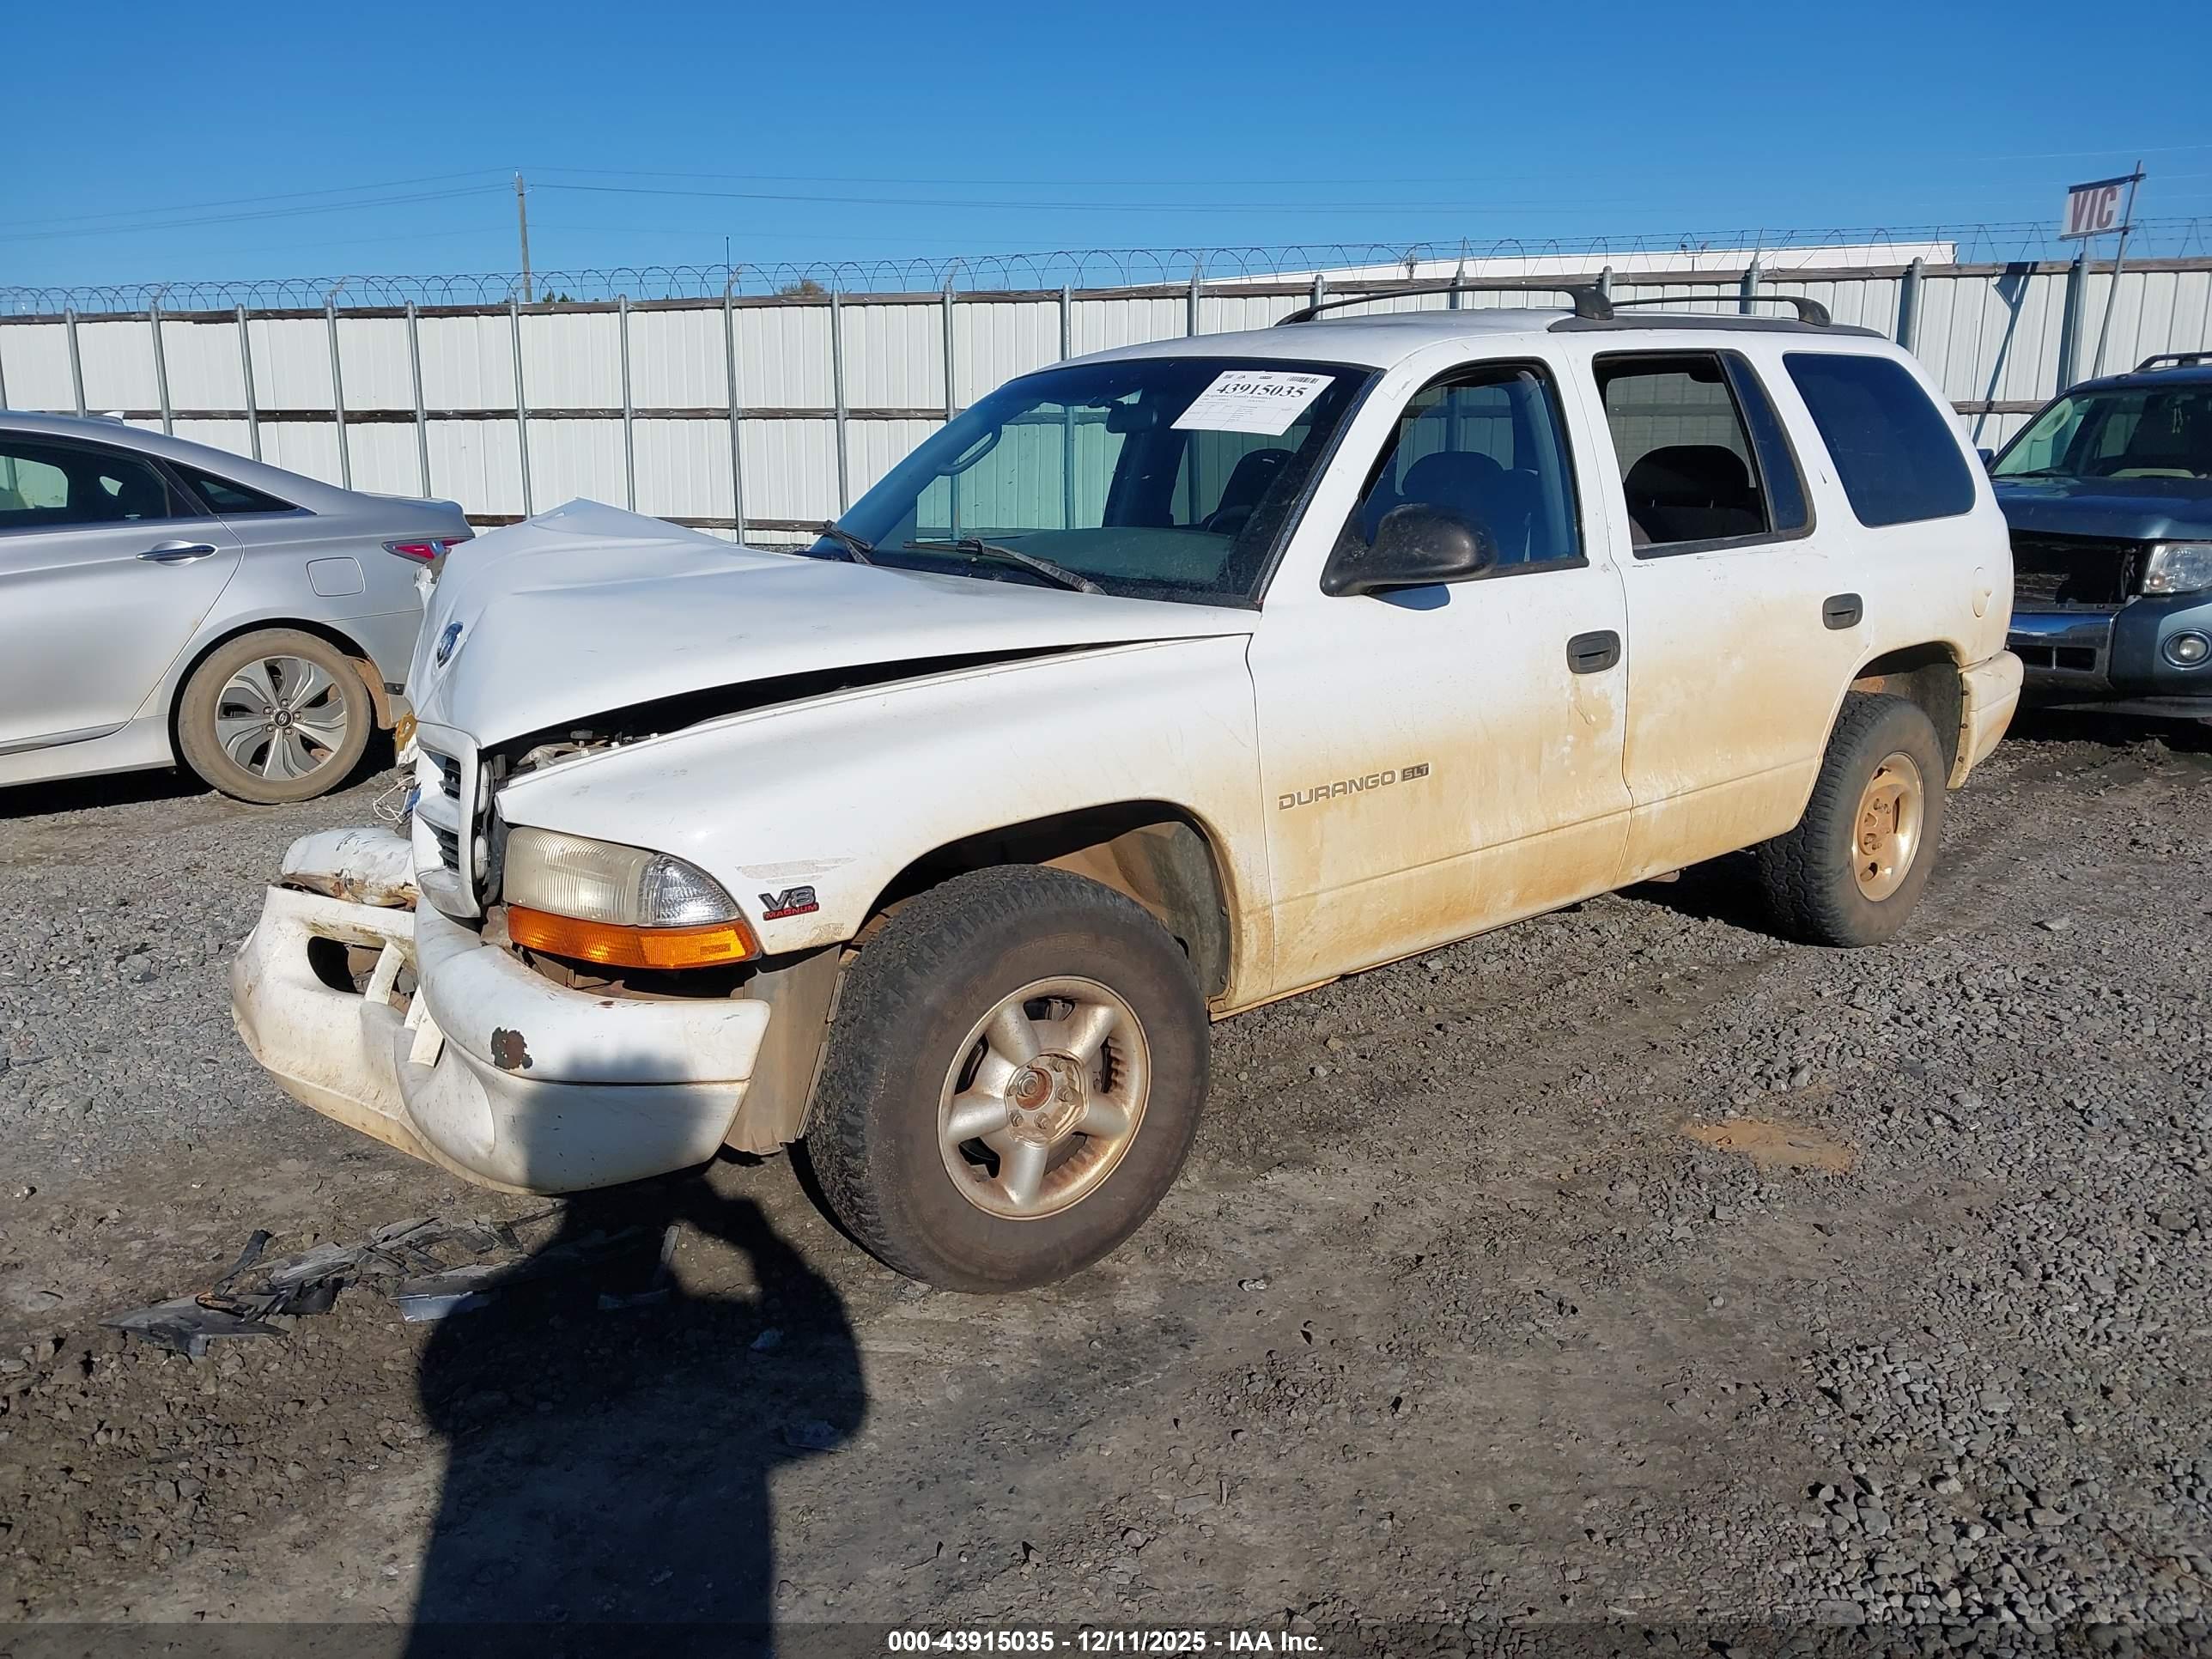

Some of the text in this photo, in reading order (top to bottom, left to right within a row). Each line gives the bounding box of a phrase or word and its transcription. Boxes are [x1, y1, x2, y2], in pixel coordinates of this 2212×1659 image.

[2070, 185, 2118, 233] VIC
[1216, 382, 1309, 399] 43915035
[1278, 763, 1430, 811] DURANGO SLT
[758, 885, 816, 912] V8
[764, 902, 818, 921] MAGNUM
